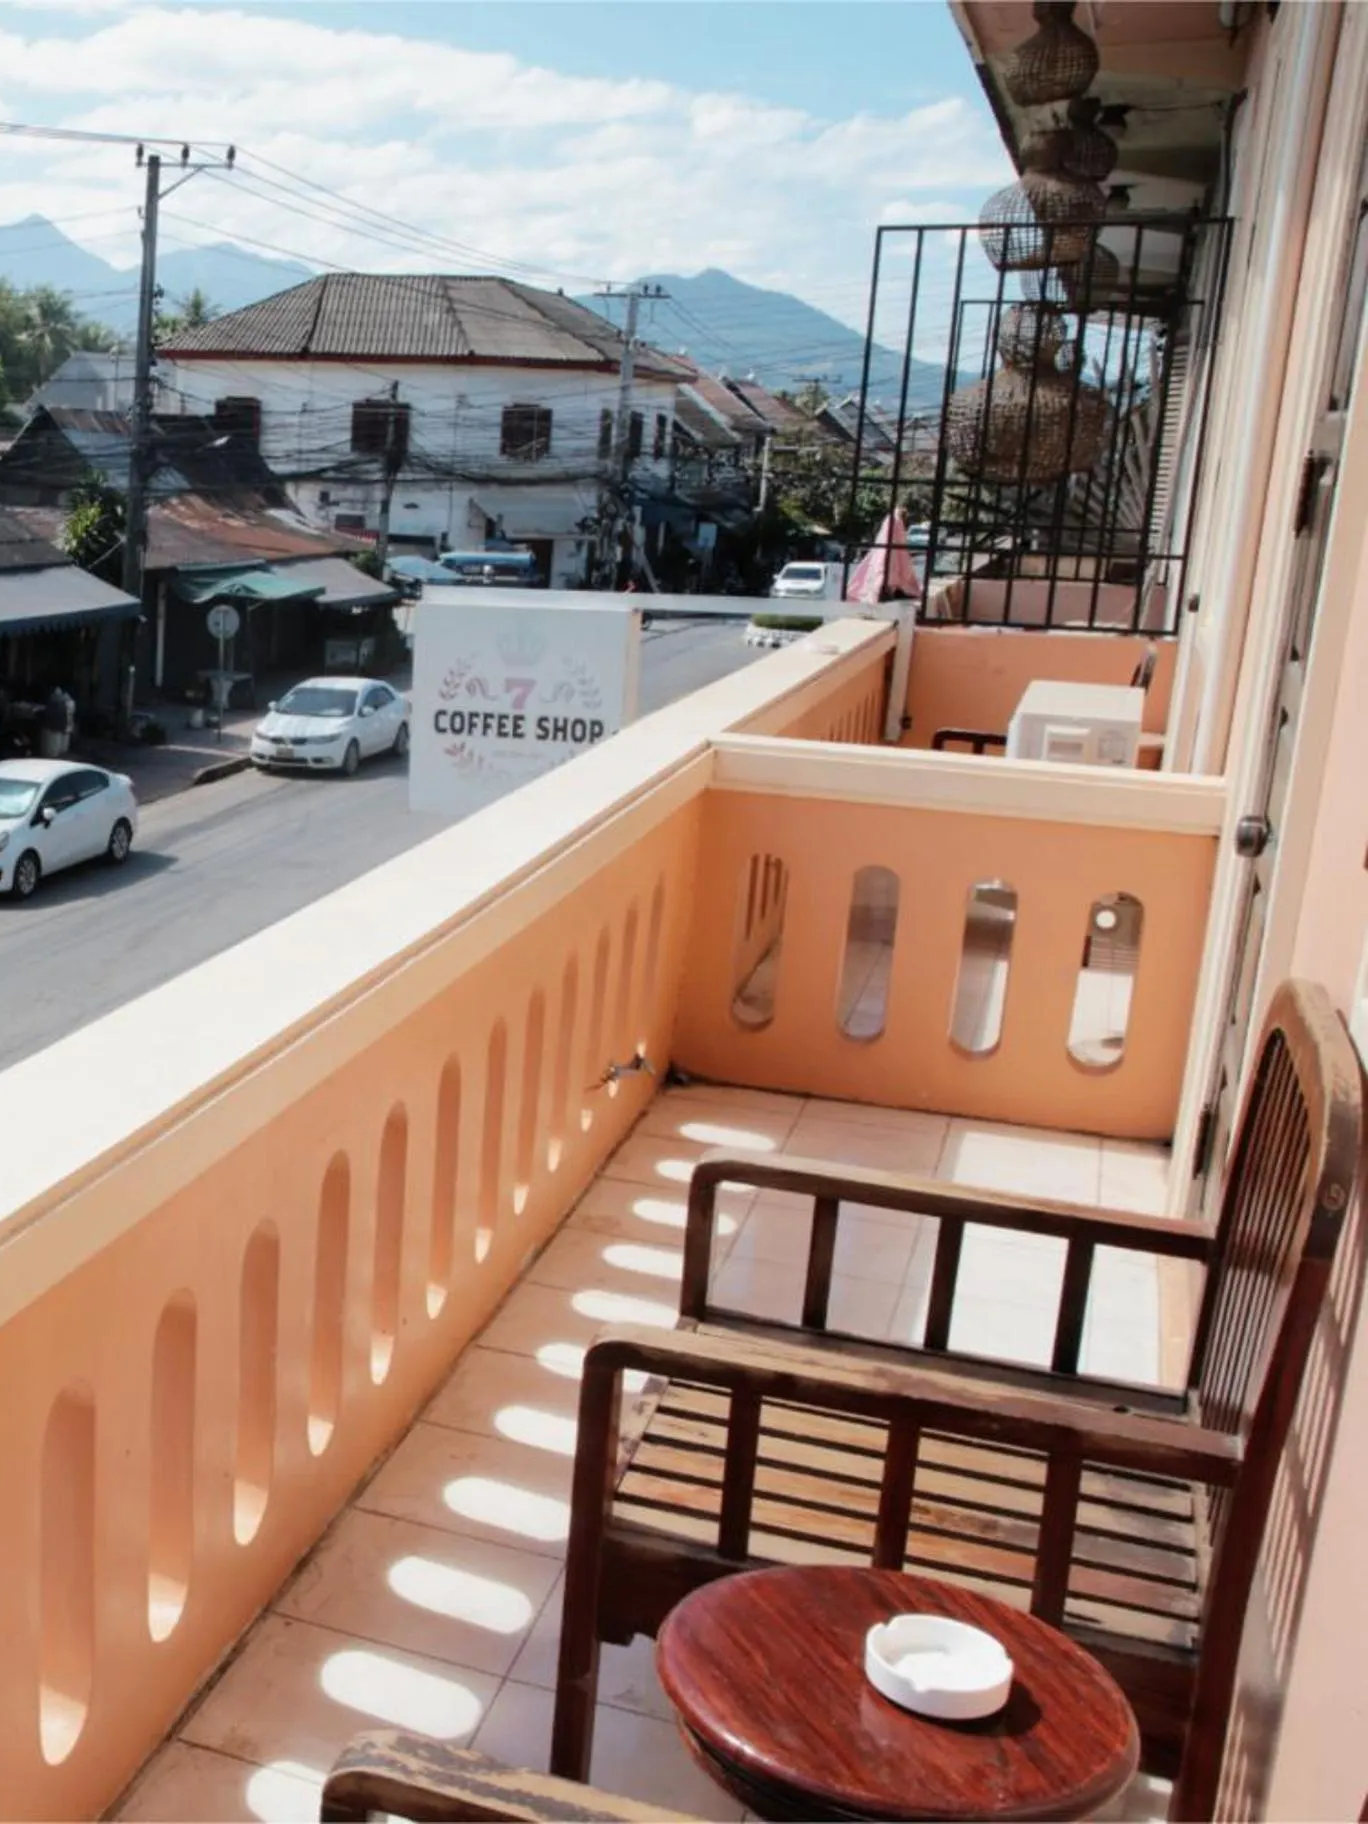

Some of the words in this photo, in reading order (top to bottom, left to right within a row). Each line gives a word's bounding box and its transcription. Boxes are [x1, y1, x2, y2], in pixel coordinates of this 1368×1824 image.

[504, 677, 537, 710] 7
[434, 709, 525, 739] COFFEE
[536, 716, 605, 745] SHOP
